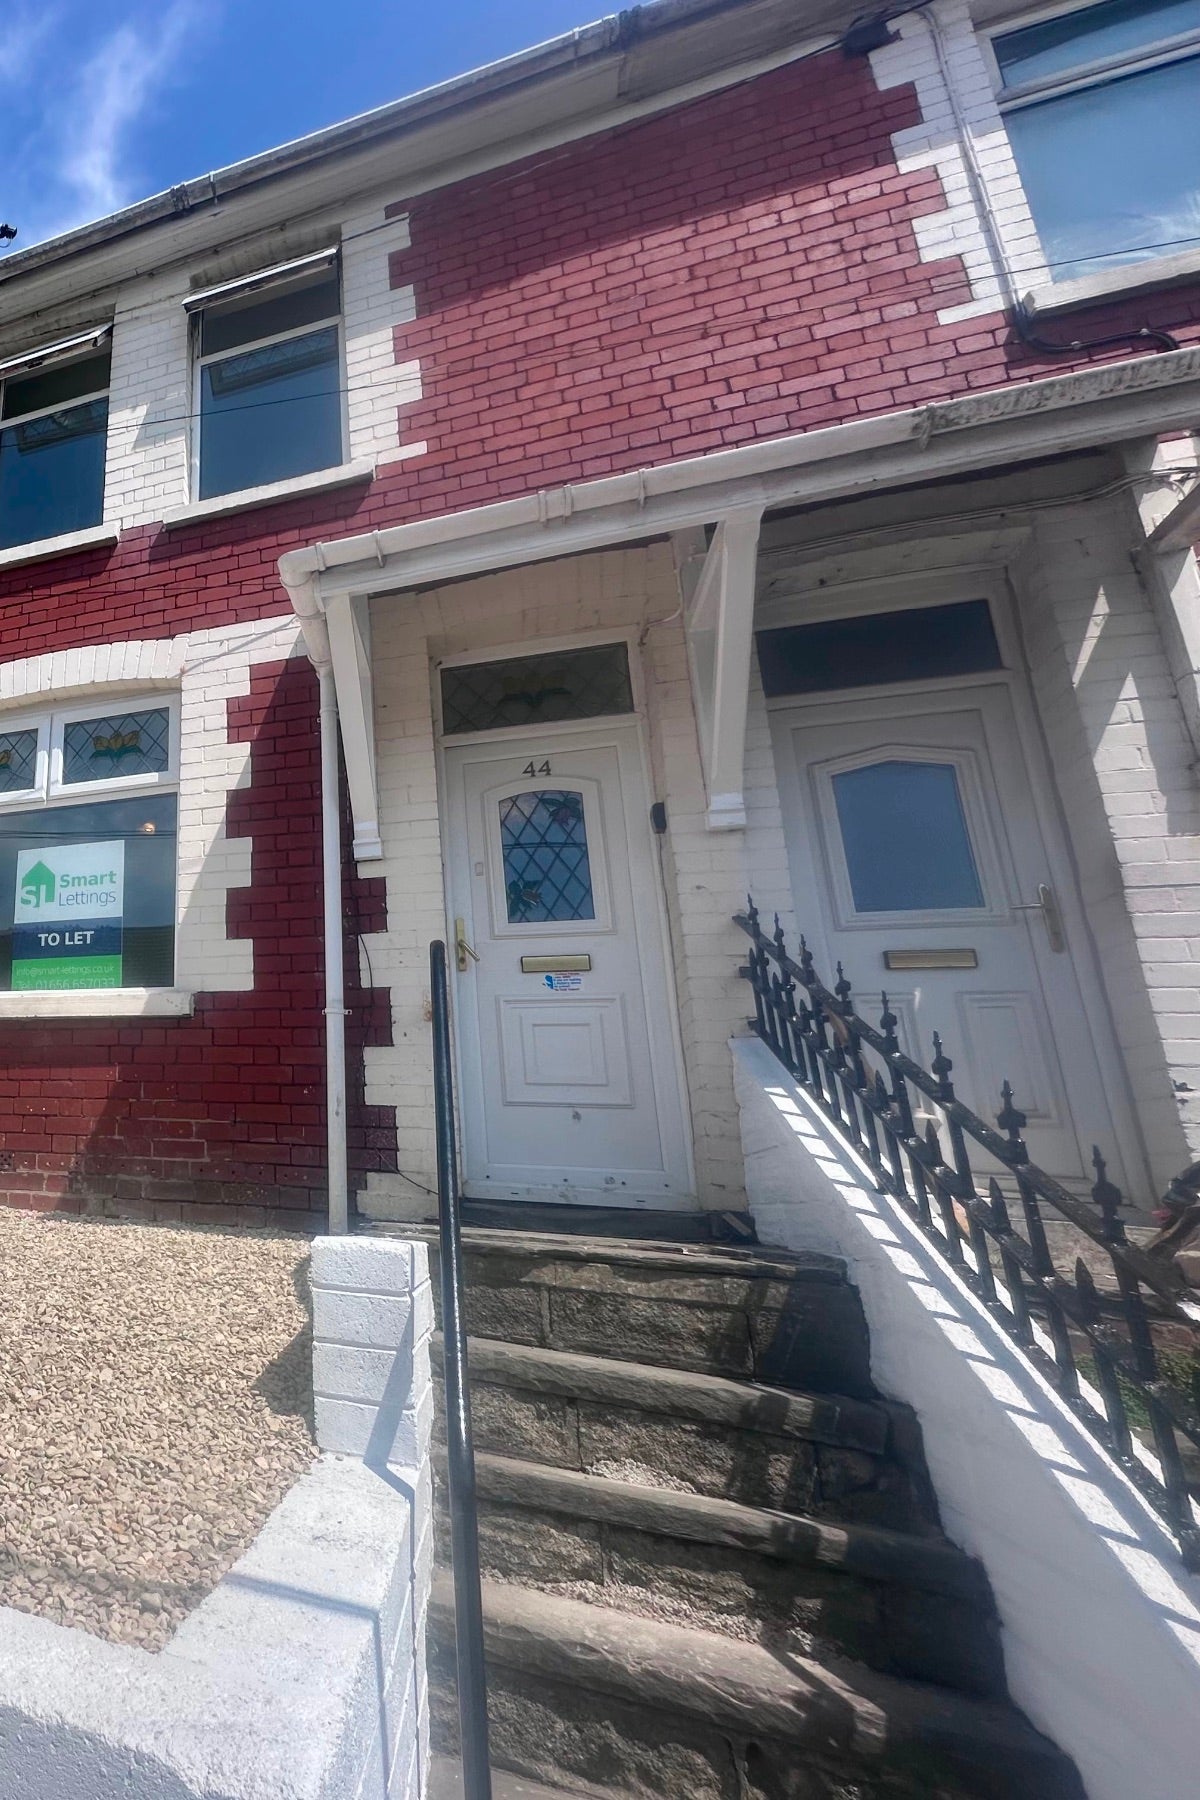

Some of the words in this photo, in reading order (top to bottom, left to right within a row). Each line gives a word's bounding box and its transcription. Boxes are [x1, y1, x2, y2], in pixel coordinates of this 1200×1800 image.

[522, 760, 551, 777] 44
[59, 870, 117, 888] Smart
[58, 890, 116, 907] Lettings
[38, 933, 60, 947] TO
[65, 930, 94, 945] LET
